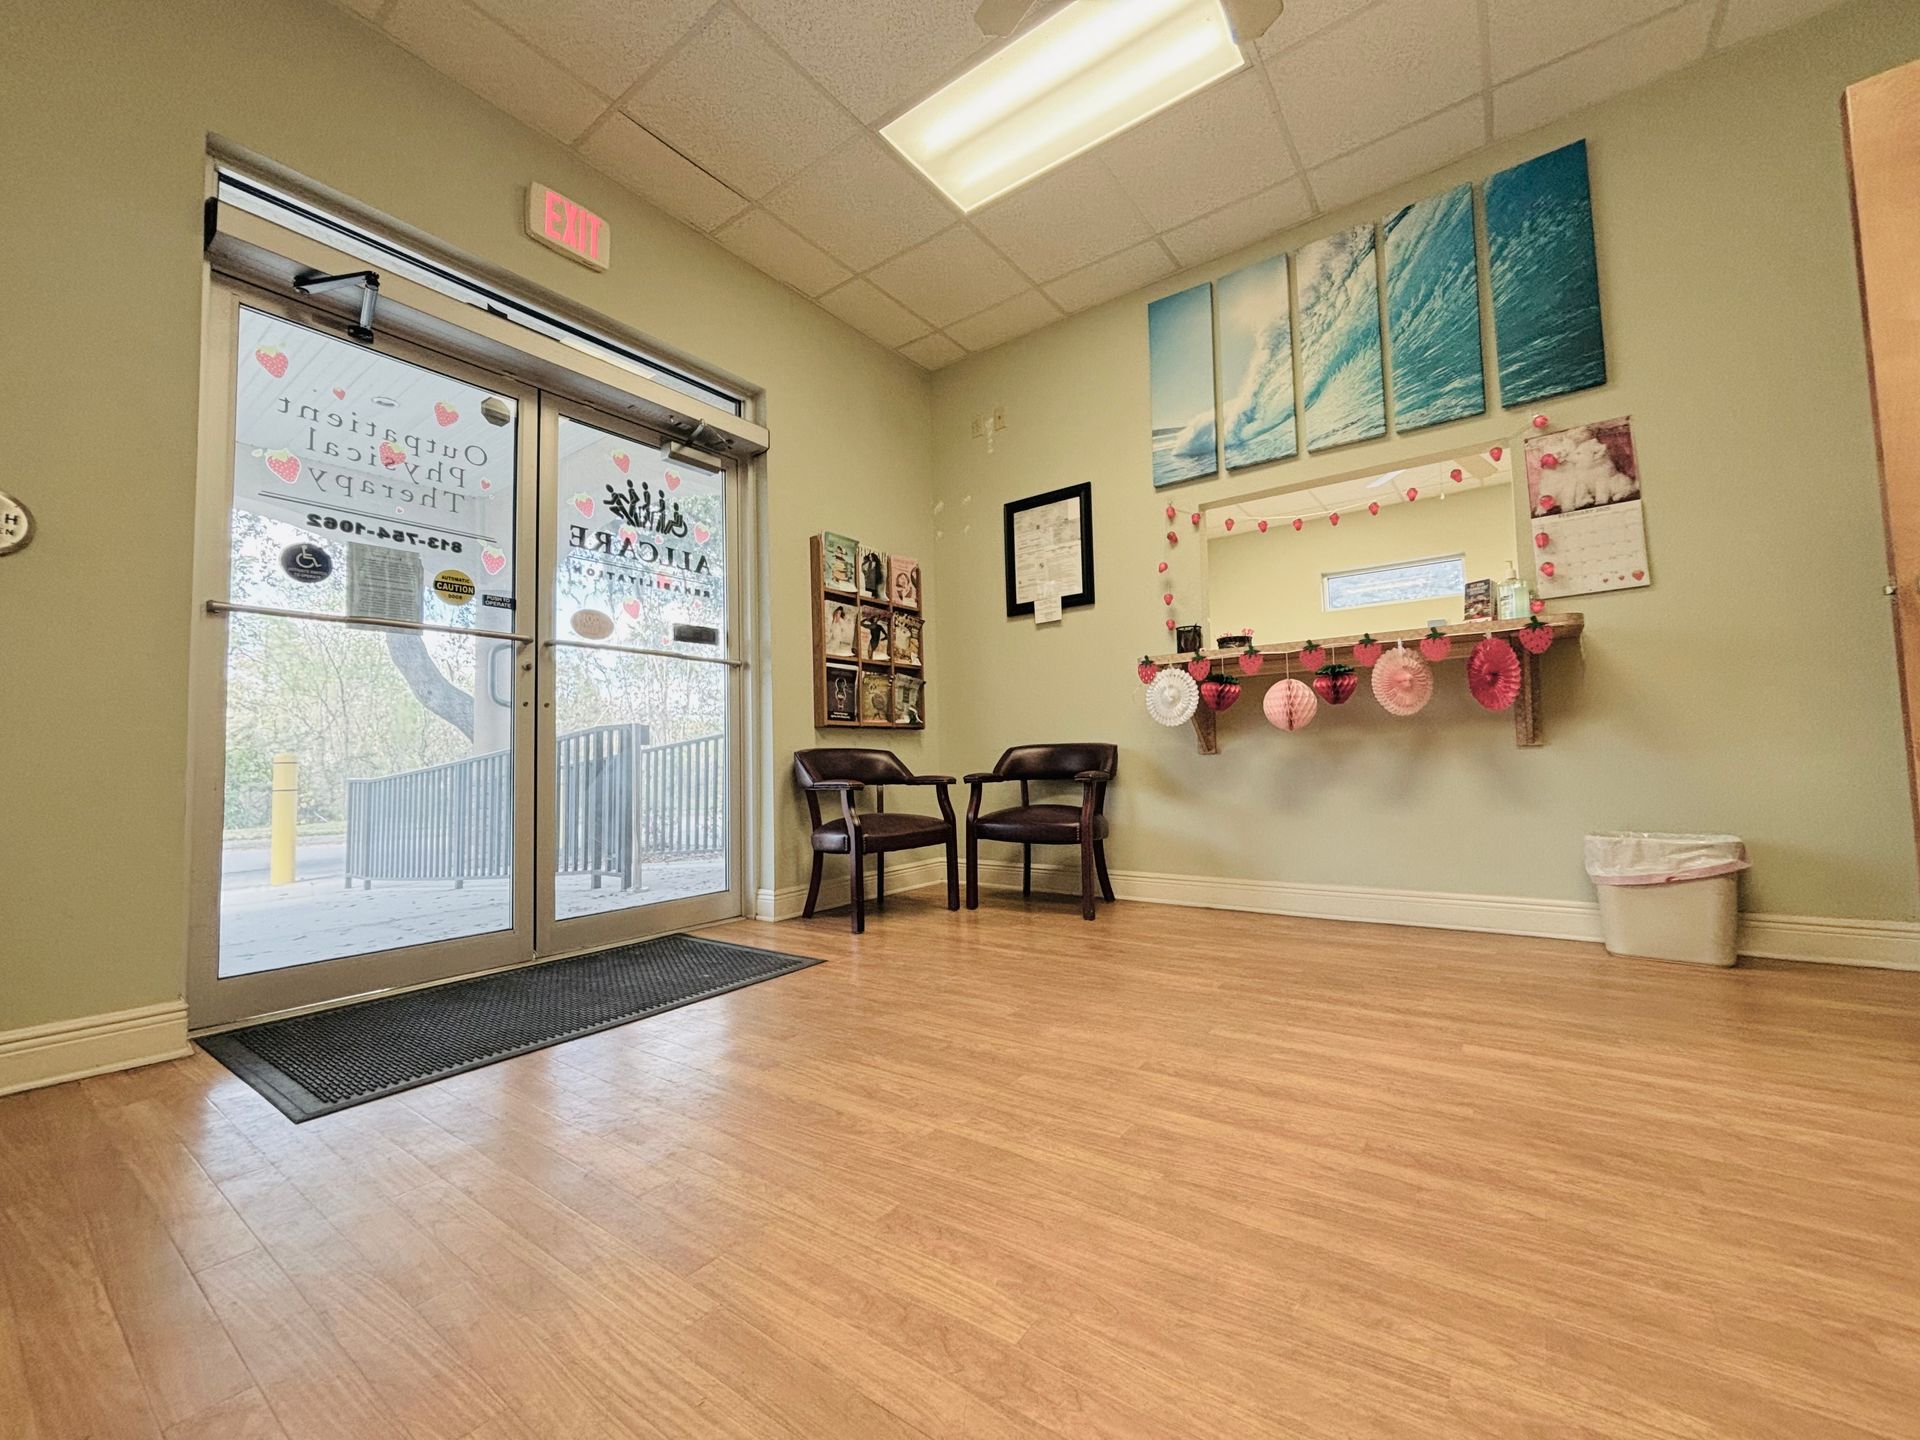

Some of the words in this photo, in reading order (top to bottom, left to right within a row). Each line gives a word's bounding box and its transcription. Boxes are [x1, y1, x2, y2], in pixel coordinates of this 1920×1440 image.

[544, 190, 602, 260] EXIT
[441, 575, 470, 584] AUTOMATIC
[436, 581, 474, 594] CAUTION
[485, 600, 512, 608] OPERATE
